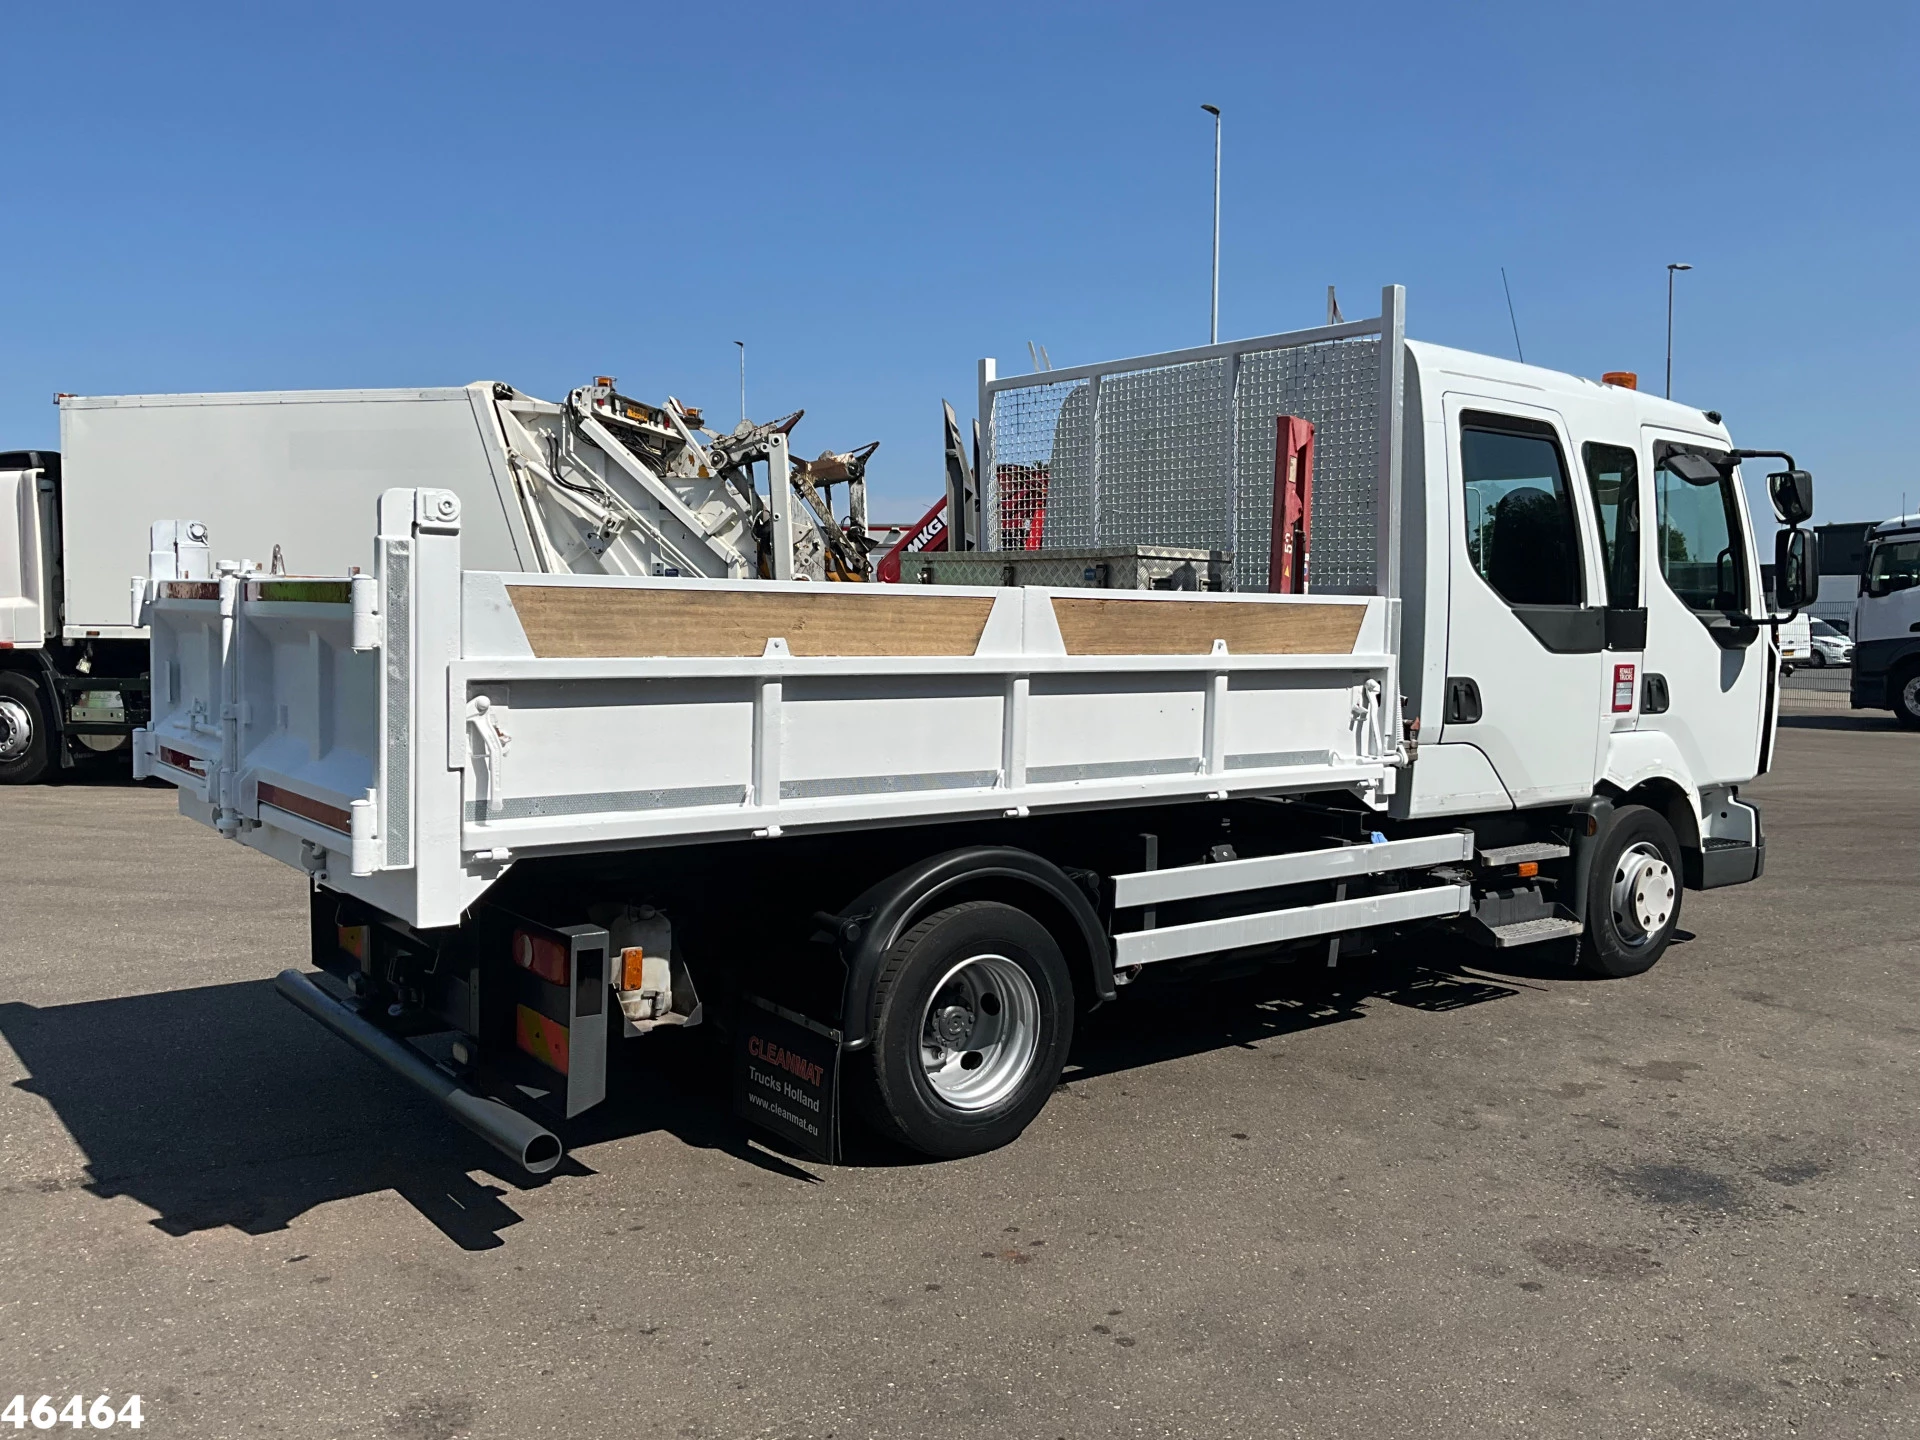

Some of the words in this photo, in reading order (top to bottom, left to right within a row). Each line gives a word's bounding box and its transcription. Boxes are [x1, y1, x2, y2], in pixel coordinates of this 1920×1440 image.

[907, 518, 943, 552] MKG
[748, 1035, 824, 1087] CLEANMAT
[749, 1065, 782, 1092] Trucks
[783, 1081, 820, 1113] Holland
[748, 1092, 818, 1137] www.cleanmat.eu
